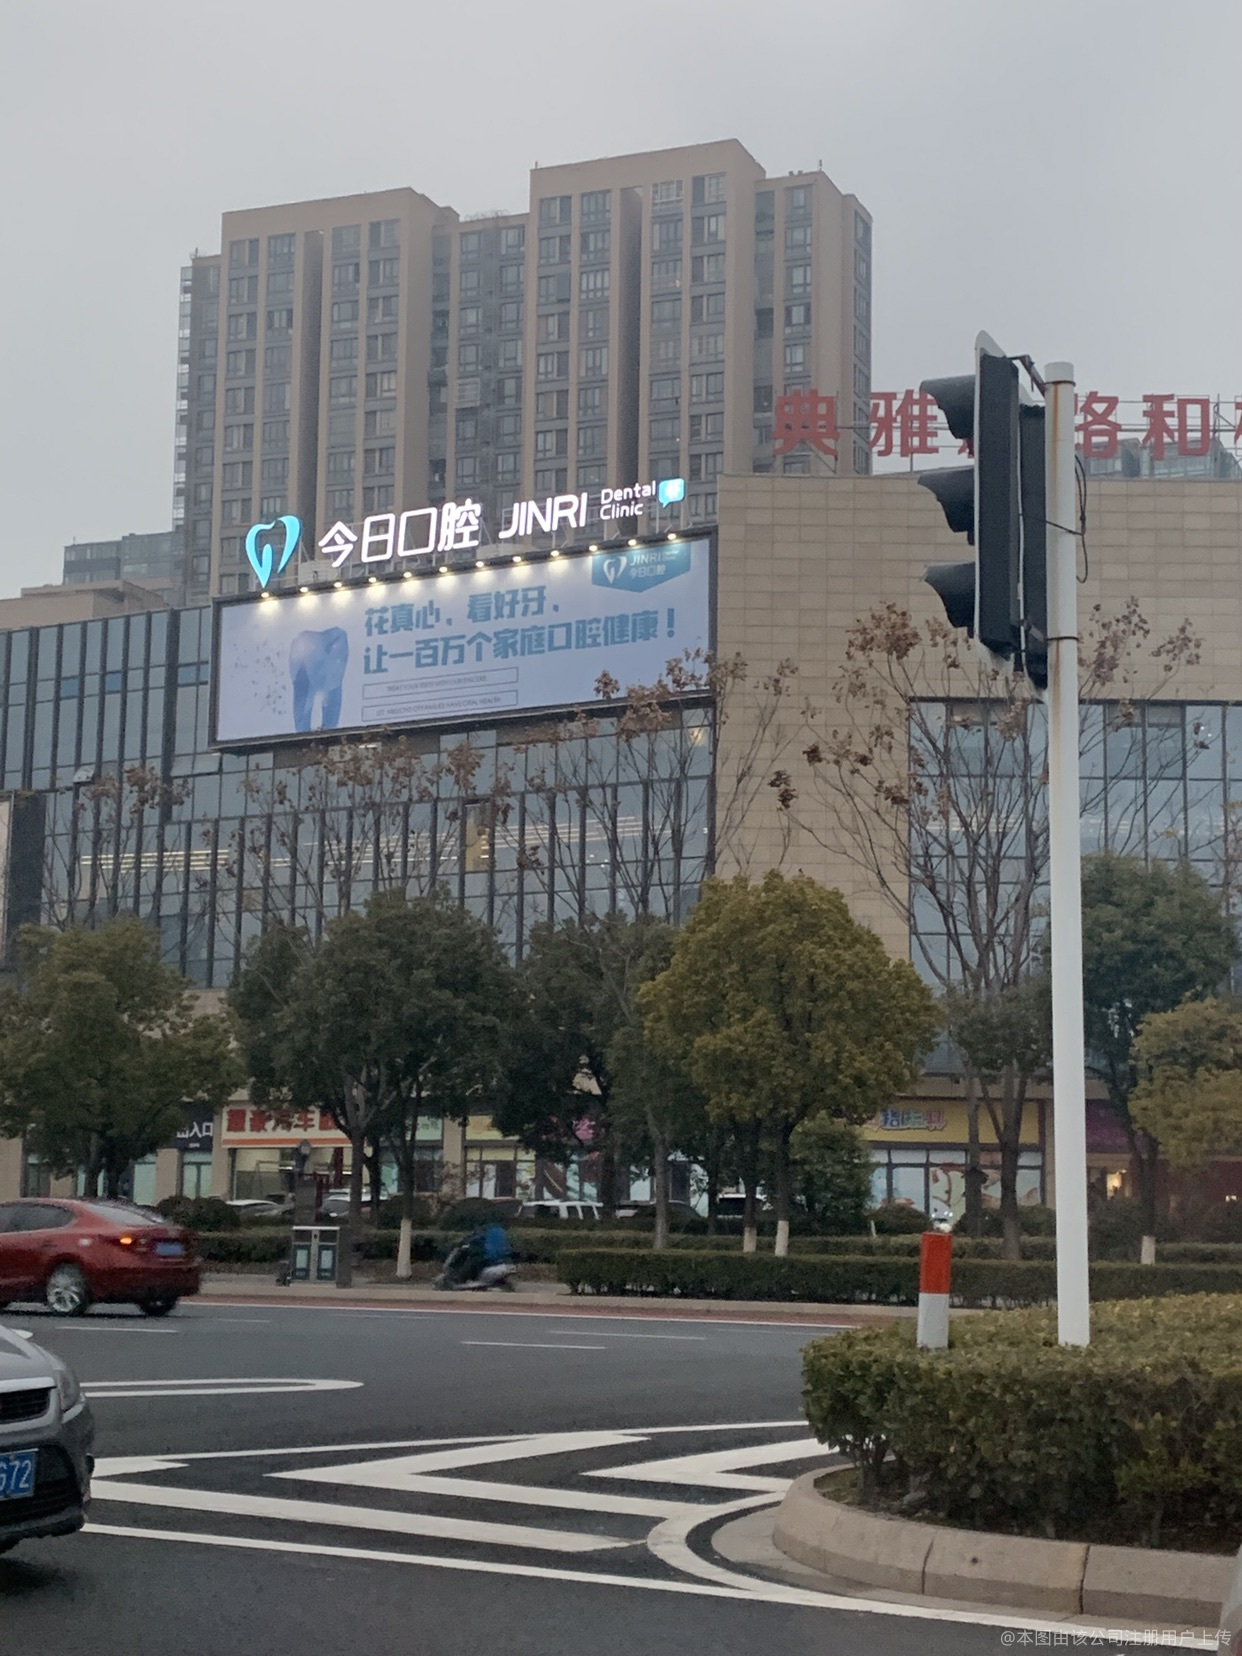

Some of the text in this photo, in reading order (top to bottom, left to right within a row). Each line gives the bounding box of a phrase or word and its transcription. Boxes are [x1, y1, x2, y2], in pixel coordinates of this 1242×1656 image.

[600, 480, 657, 505] Dental
[498, 492, 588, 539] JINRI
[600, 501, 644, 520] Clinic
[318, 498, 482, 568] 今日口腔
[630, 552, 661, 567] JINRI
[630, 564, 666, 579] 今日口腔
